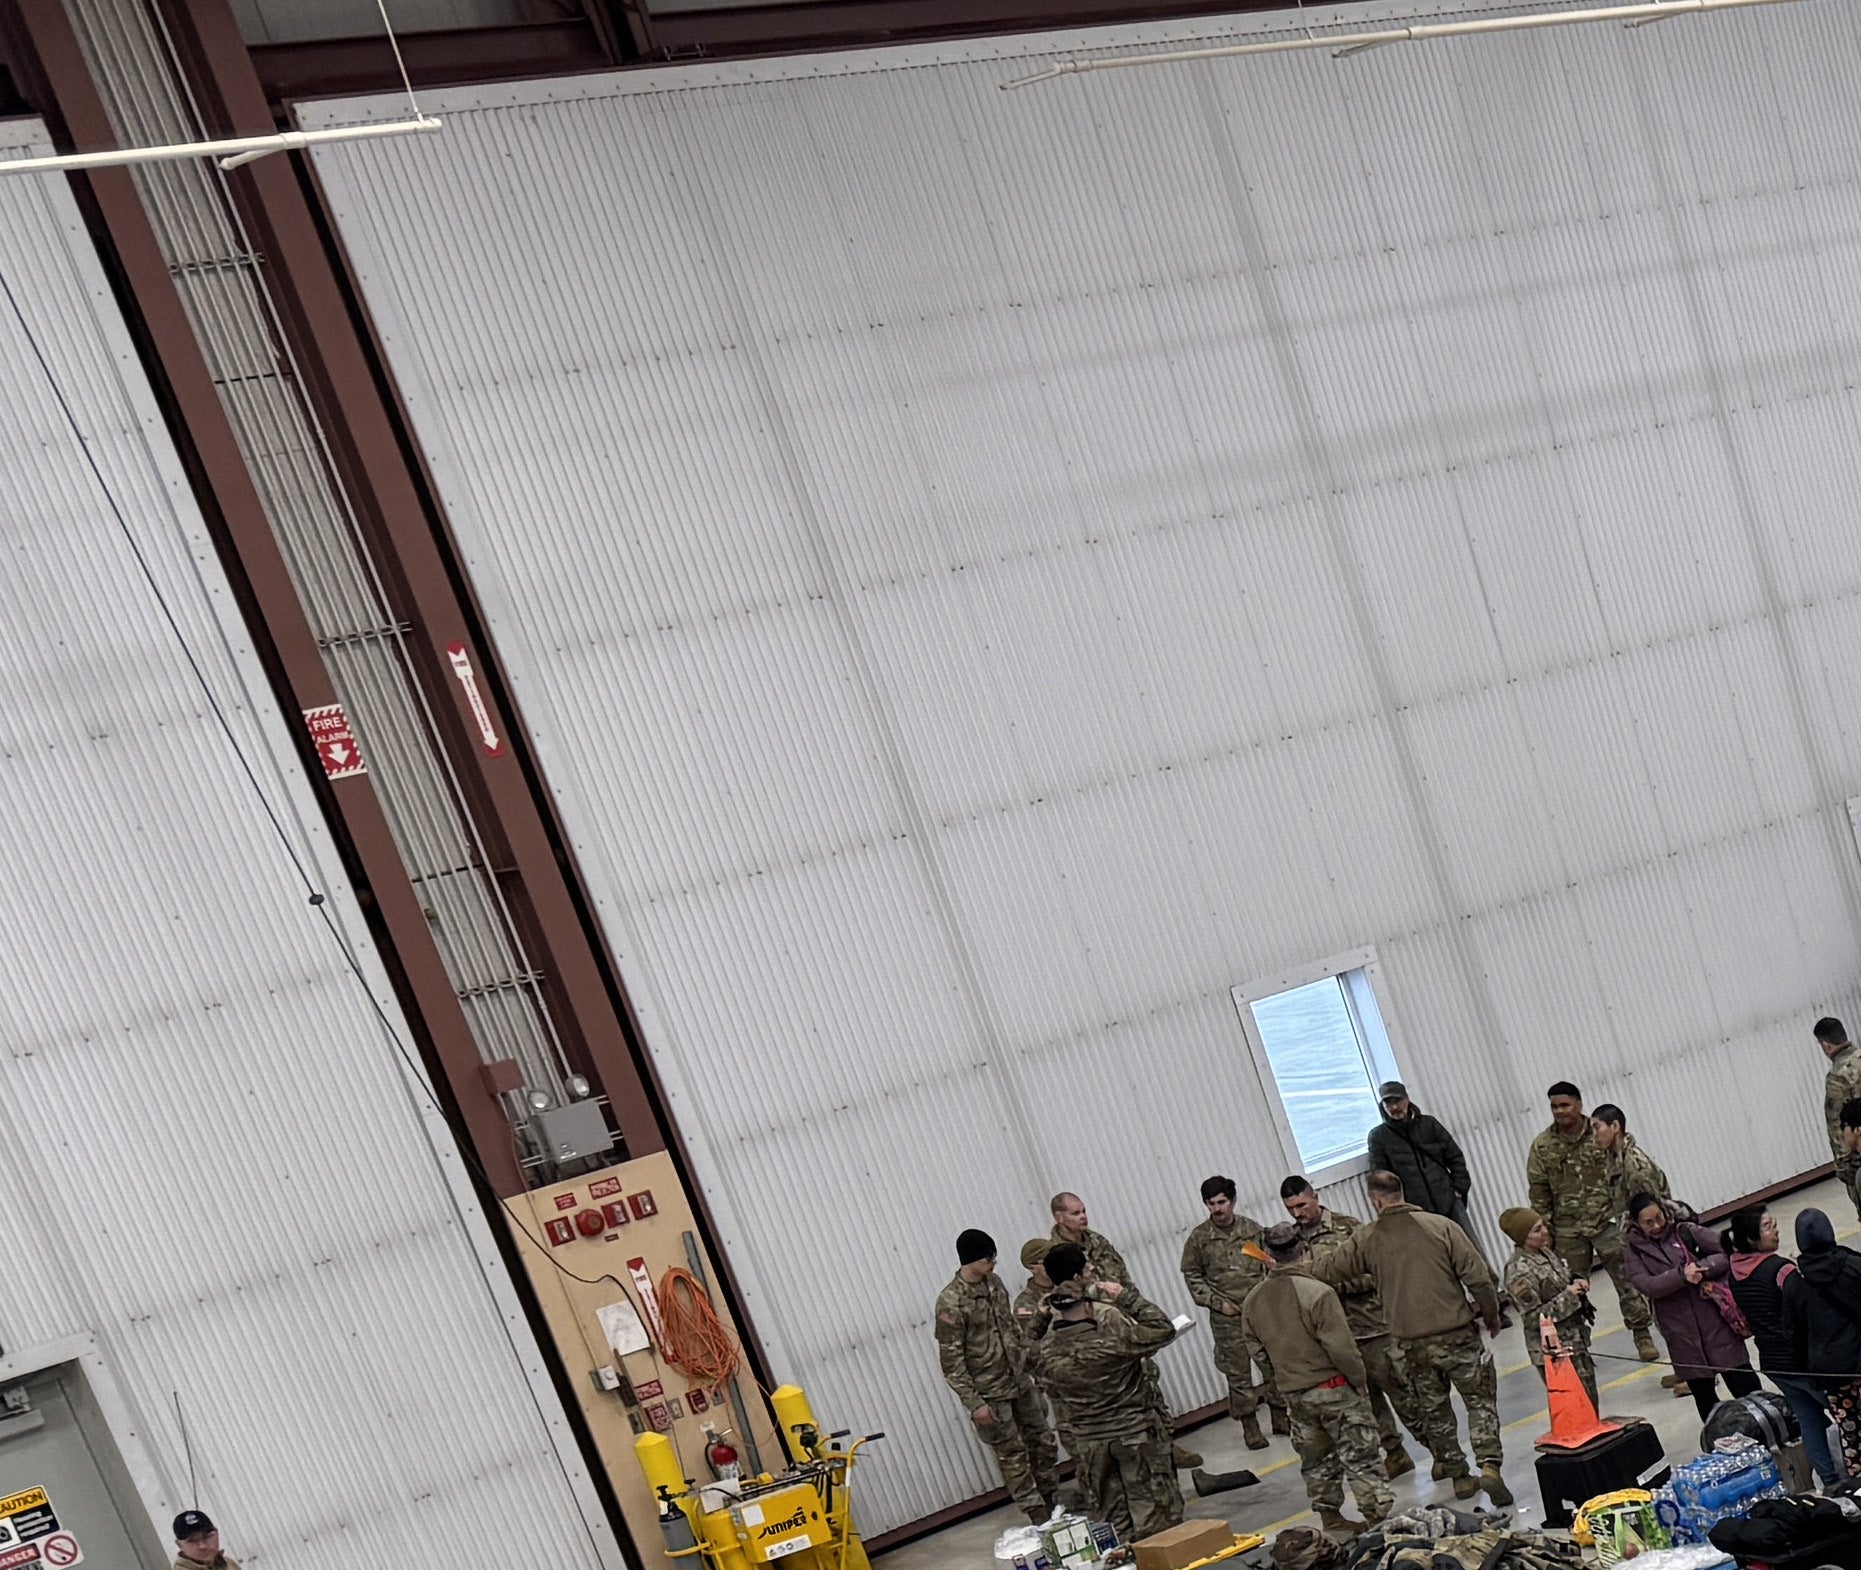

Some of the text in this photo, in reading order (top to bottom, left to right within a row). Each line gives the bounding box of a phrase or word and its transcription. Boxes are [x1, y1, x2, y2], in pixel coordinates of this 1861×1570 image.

[312, 717, 343, 731] FIRE
[317, 731, 349, 743] ALARM
[0, 1491, 44, 1514] AUTION
[758, 1514, 807, 1540] JUNIPER
[0, 1547, 37, 1566] ANGER
